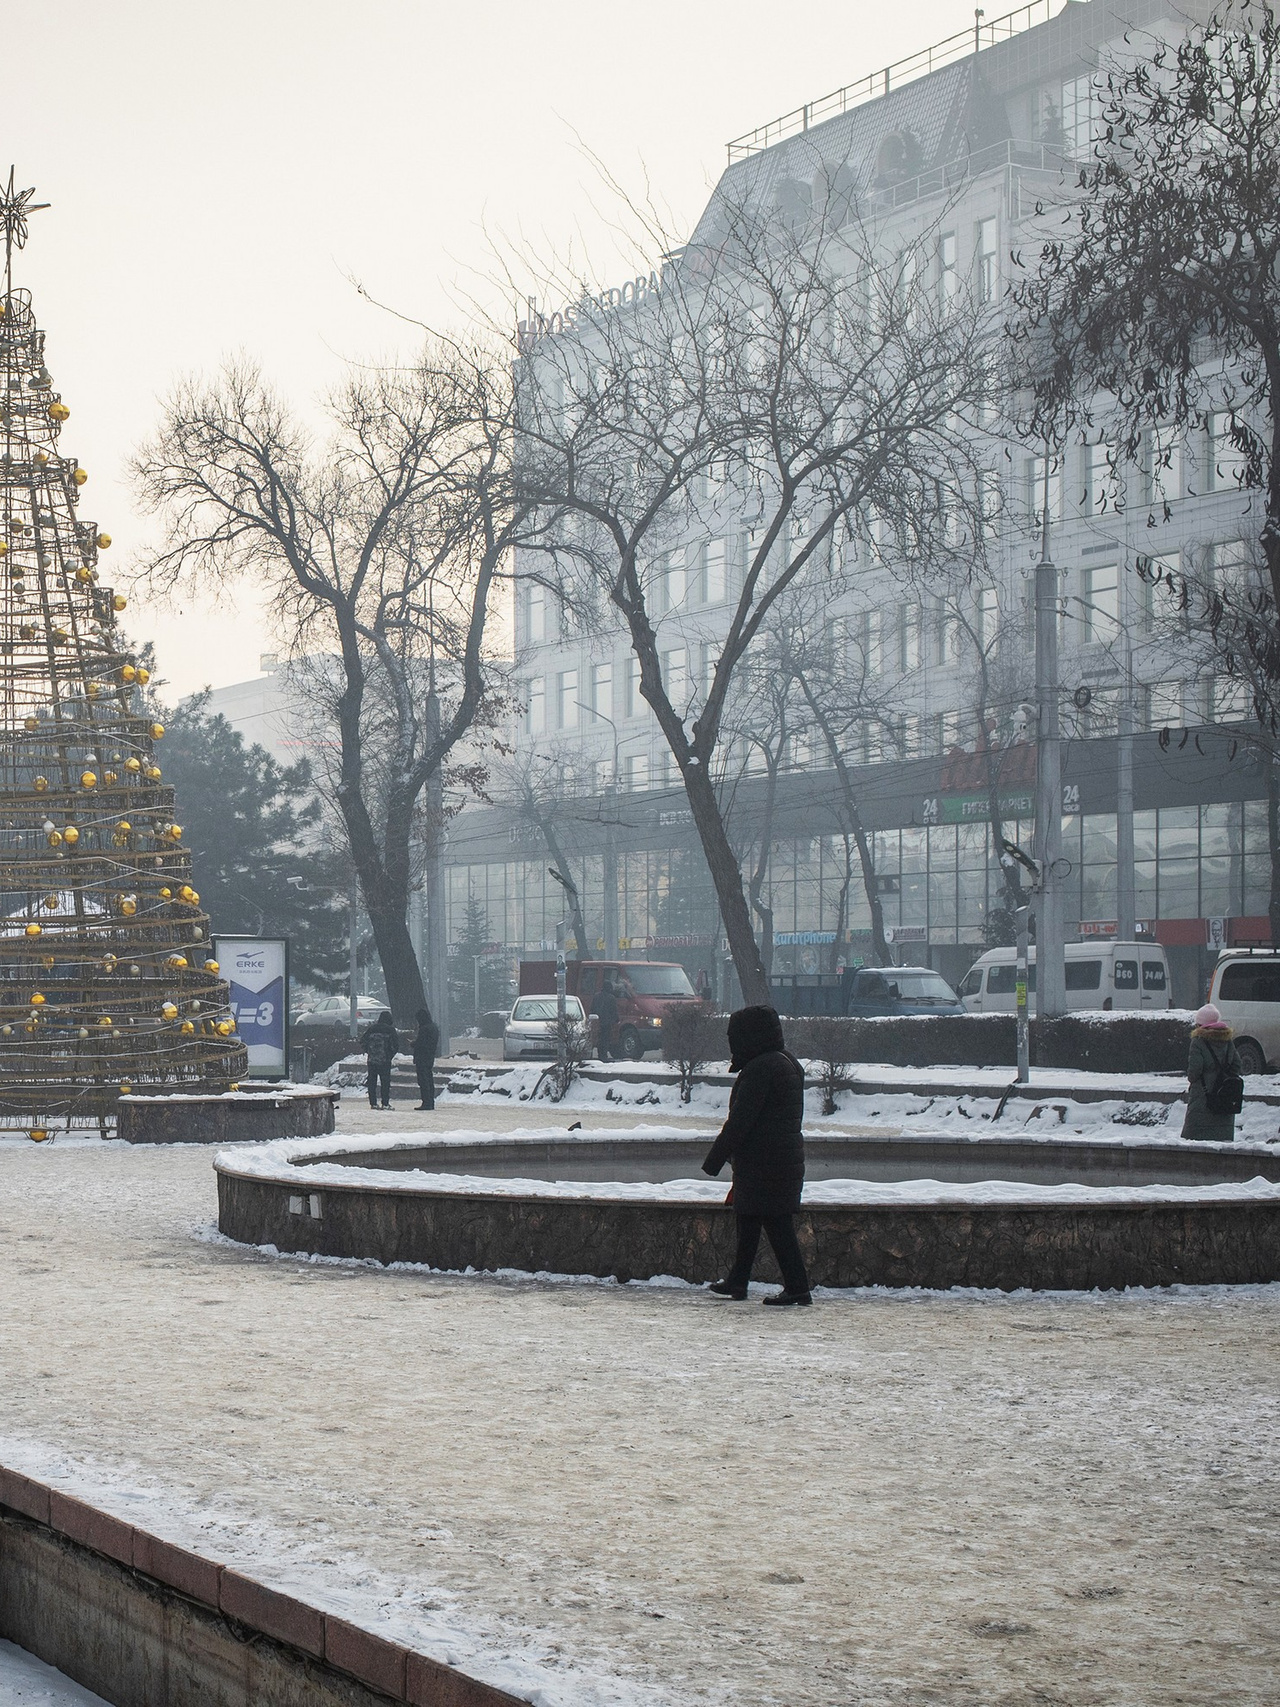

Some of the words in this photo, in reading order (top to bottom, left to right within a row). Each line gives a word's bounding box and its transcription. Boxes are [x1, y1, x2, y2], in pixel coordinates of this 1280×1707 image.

[1063, 785, 1080, 804] 24
[923, 799, 939, 817] 24
[962, 797, 1033, 815] ГИПЕАРКЕТ
[236, 960, 265, 968] ERKE
